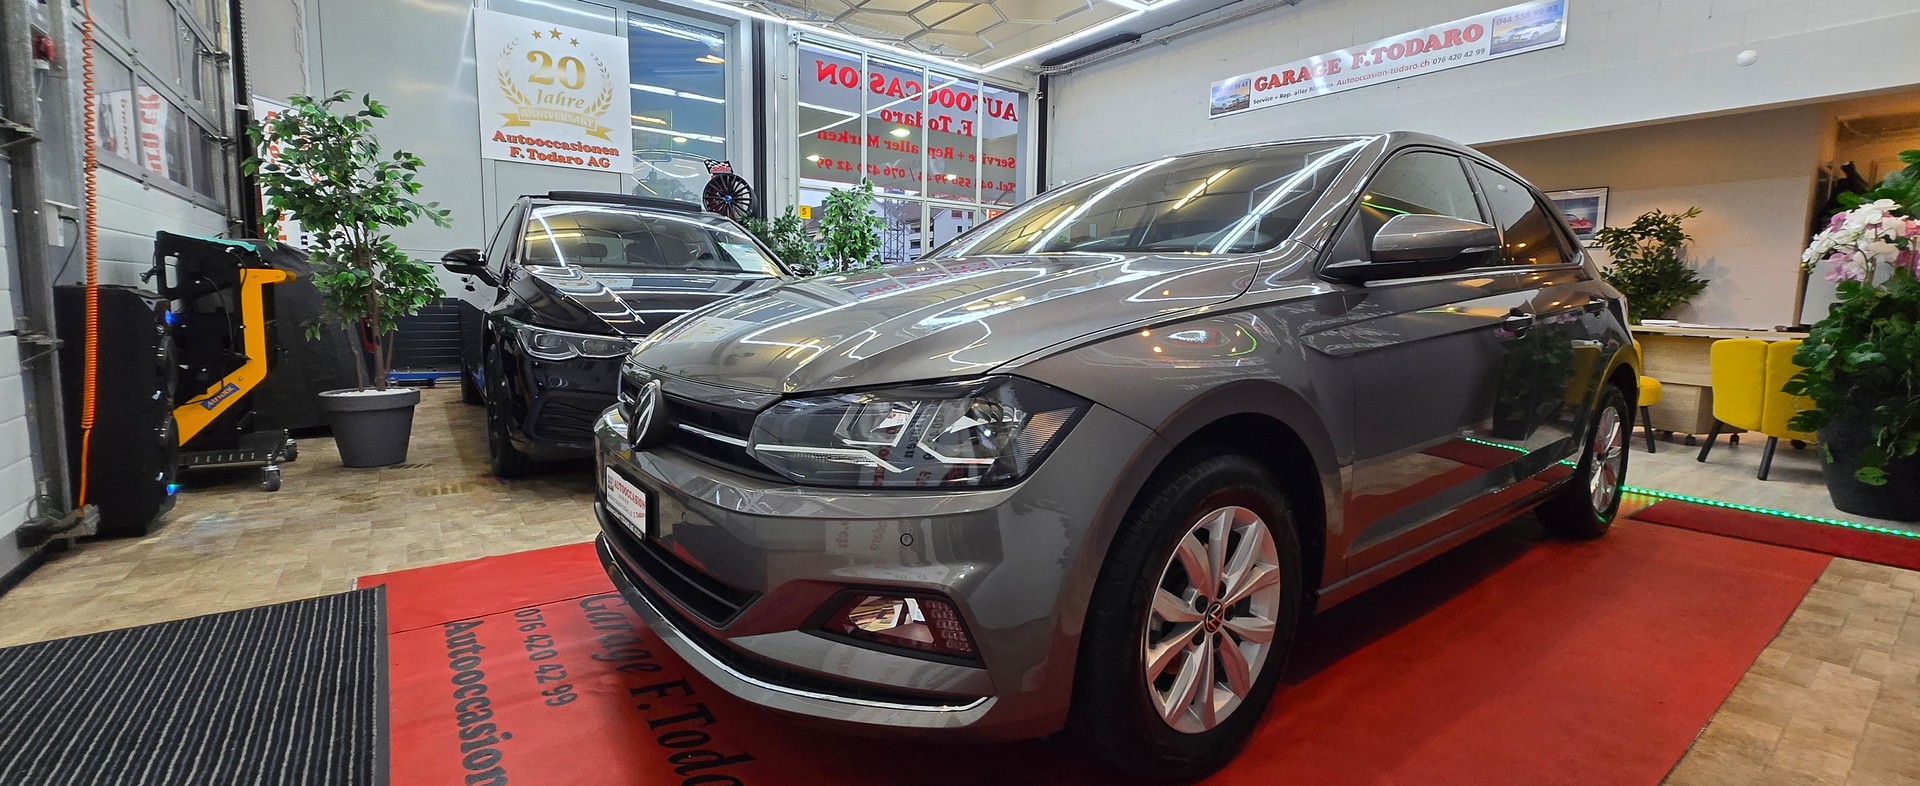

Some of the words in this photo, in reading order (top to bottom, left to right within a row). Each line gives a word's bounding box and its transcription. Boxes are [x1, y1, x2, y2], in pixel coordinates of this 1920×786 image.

[527, 50, 586, 90] 20
[1254, 58, 1342, 92] GARAGE
[1350, 24, 1484, 70] F.TODARO
[1253, 96, 1274, 105] Service
[1294, 88, 1308, 96] aller
[1336, 60, 1430, 86] Autooccasion-todaro.ch
[1432, 57, 1446, 65] 076
[1448, 54, 1462, 62] 420
[1464, 50, 1474, 58] 42
[1476, 48, 1486, 56] 99
[536, 89, 585, 109] Jahre
[520, 108, 595, 128] ANNIVERSARY
[492, 130, 620, 156] Autooccasionen
[510, 146, 524, 158] F.
[527, 148, 584, 166] Todaro
[586, 156, 610, 168] AG
[514, 608, 546, 632] 076
[579, 594, 663, 673] Garage
[524, 634, 558, 661] 420
[534, 664, 568, 684] 42
[541, 684, 578, 706] 99
